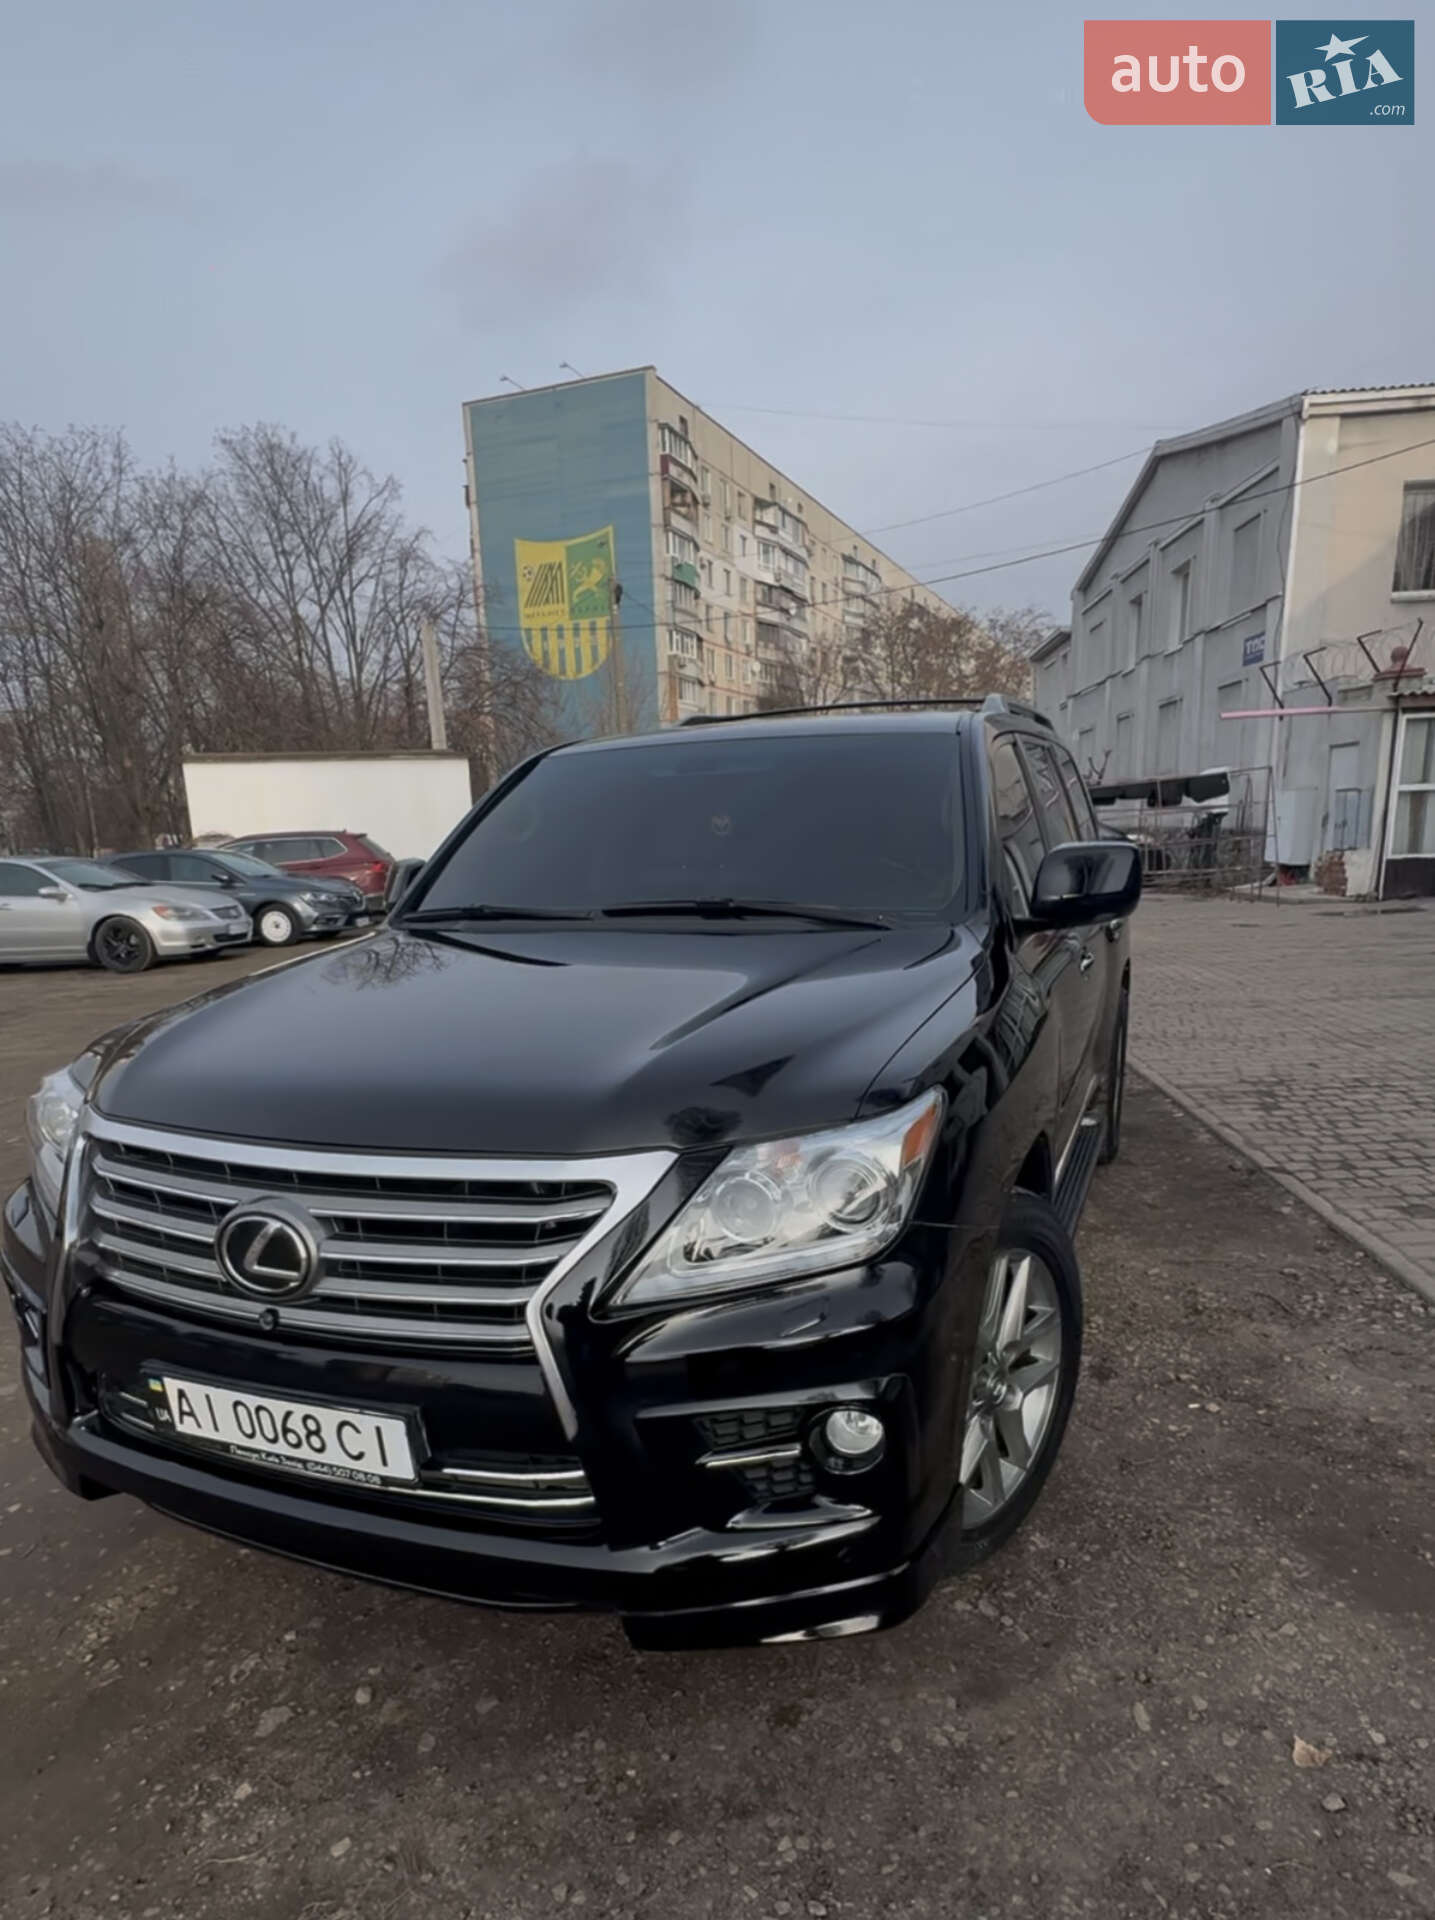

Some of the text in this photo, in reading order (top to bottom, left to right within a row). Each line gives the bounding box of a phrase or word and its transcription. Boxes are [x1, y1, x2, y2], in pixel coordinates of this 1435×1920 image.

[177, 1388, 219, 1432] AI
[233, 1400, 327, 1454] 0068
[336, 1420, 389, 1467] CI
